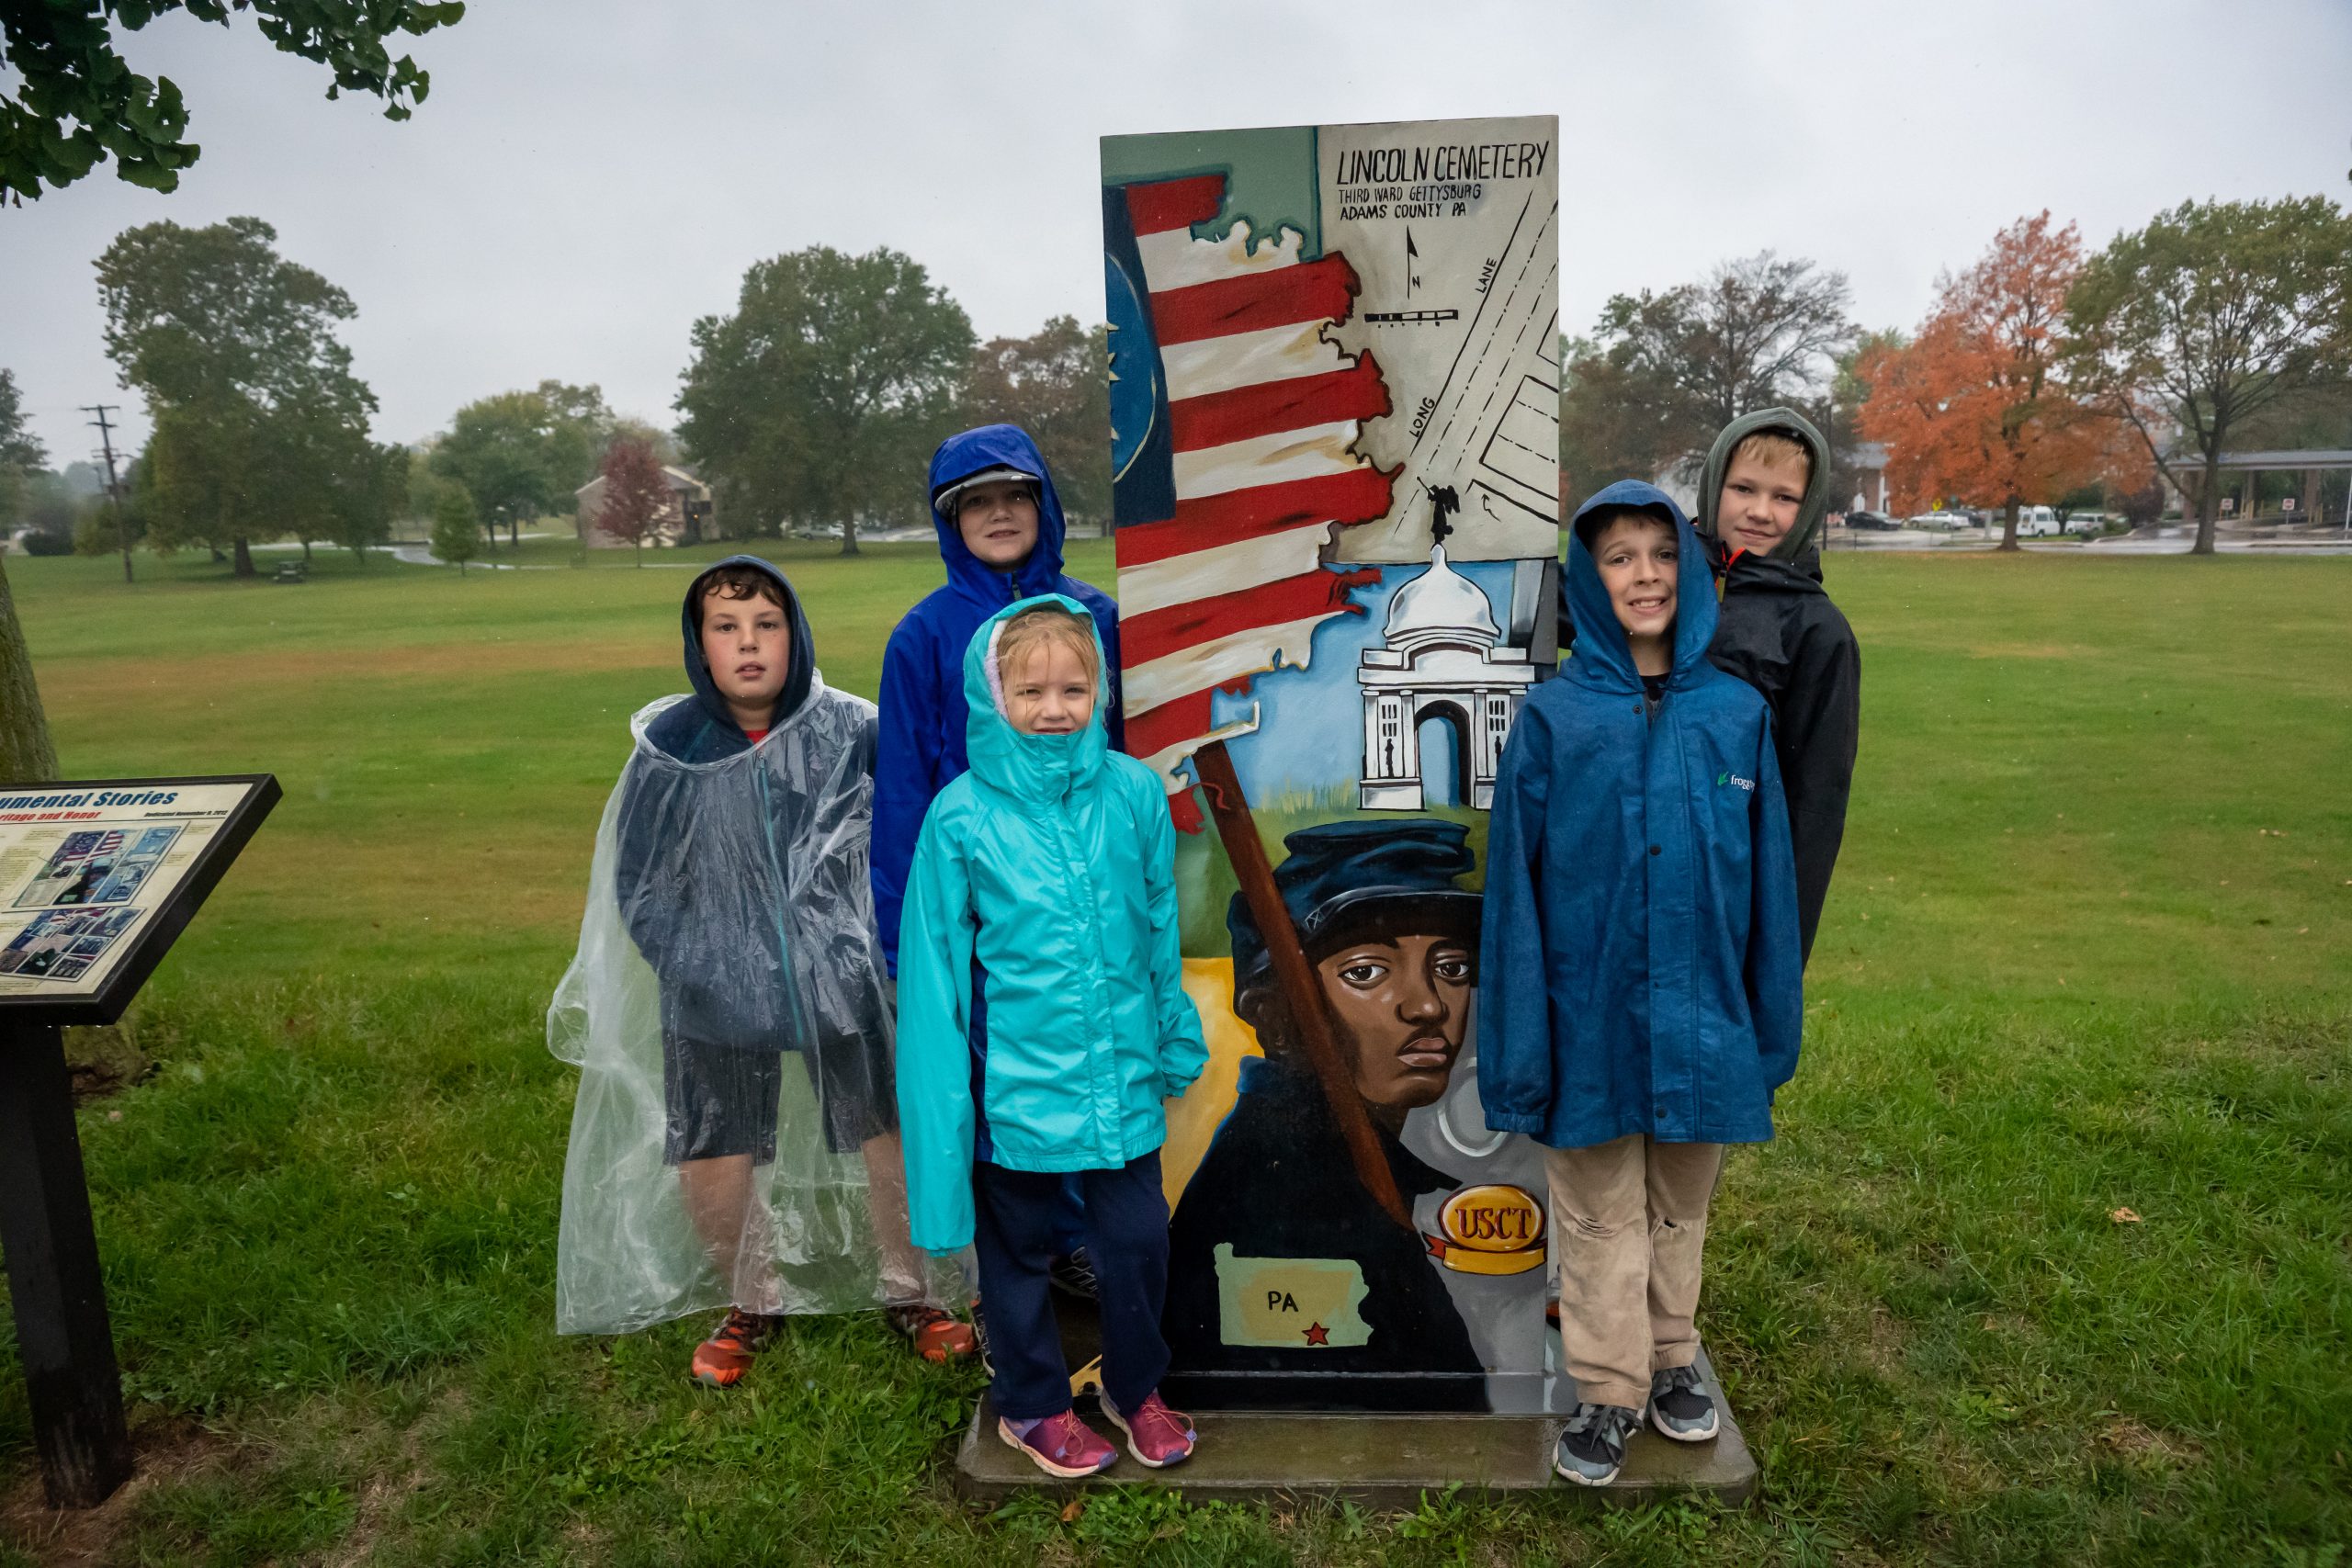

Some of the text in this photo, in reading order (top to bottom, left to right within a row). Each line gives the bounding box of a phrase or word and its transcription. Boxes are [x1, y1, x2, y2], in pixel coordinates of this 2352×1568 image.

[1337, 141, 1549, 185] LINCOLN CEMETERY
[1339, 186, 1370, 204] THIRD
[1409, 184, 1482, 201] GETTYSBURG
[1340, 202, 1466, 220] ADAMS COUNTY PA
[1411, 276, 1421, 289] N
[1476, 257, 1498, 294] LANE
[1408, 397, 1435, 438] LONG
[93, 791, 178, 807] Stories
[37, 812, 63, 820] and
[62, 811, 102, 819] Honor
[1455, 1207, 1532, 1240] USCT
[1268, 1291, 1299, 1312] PA
